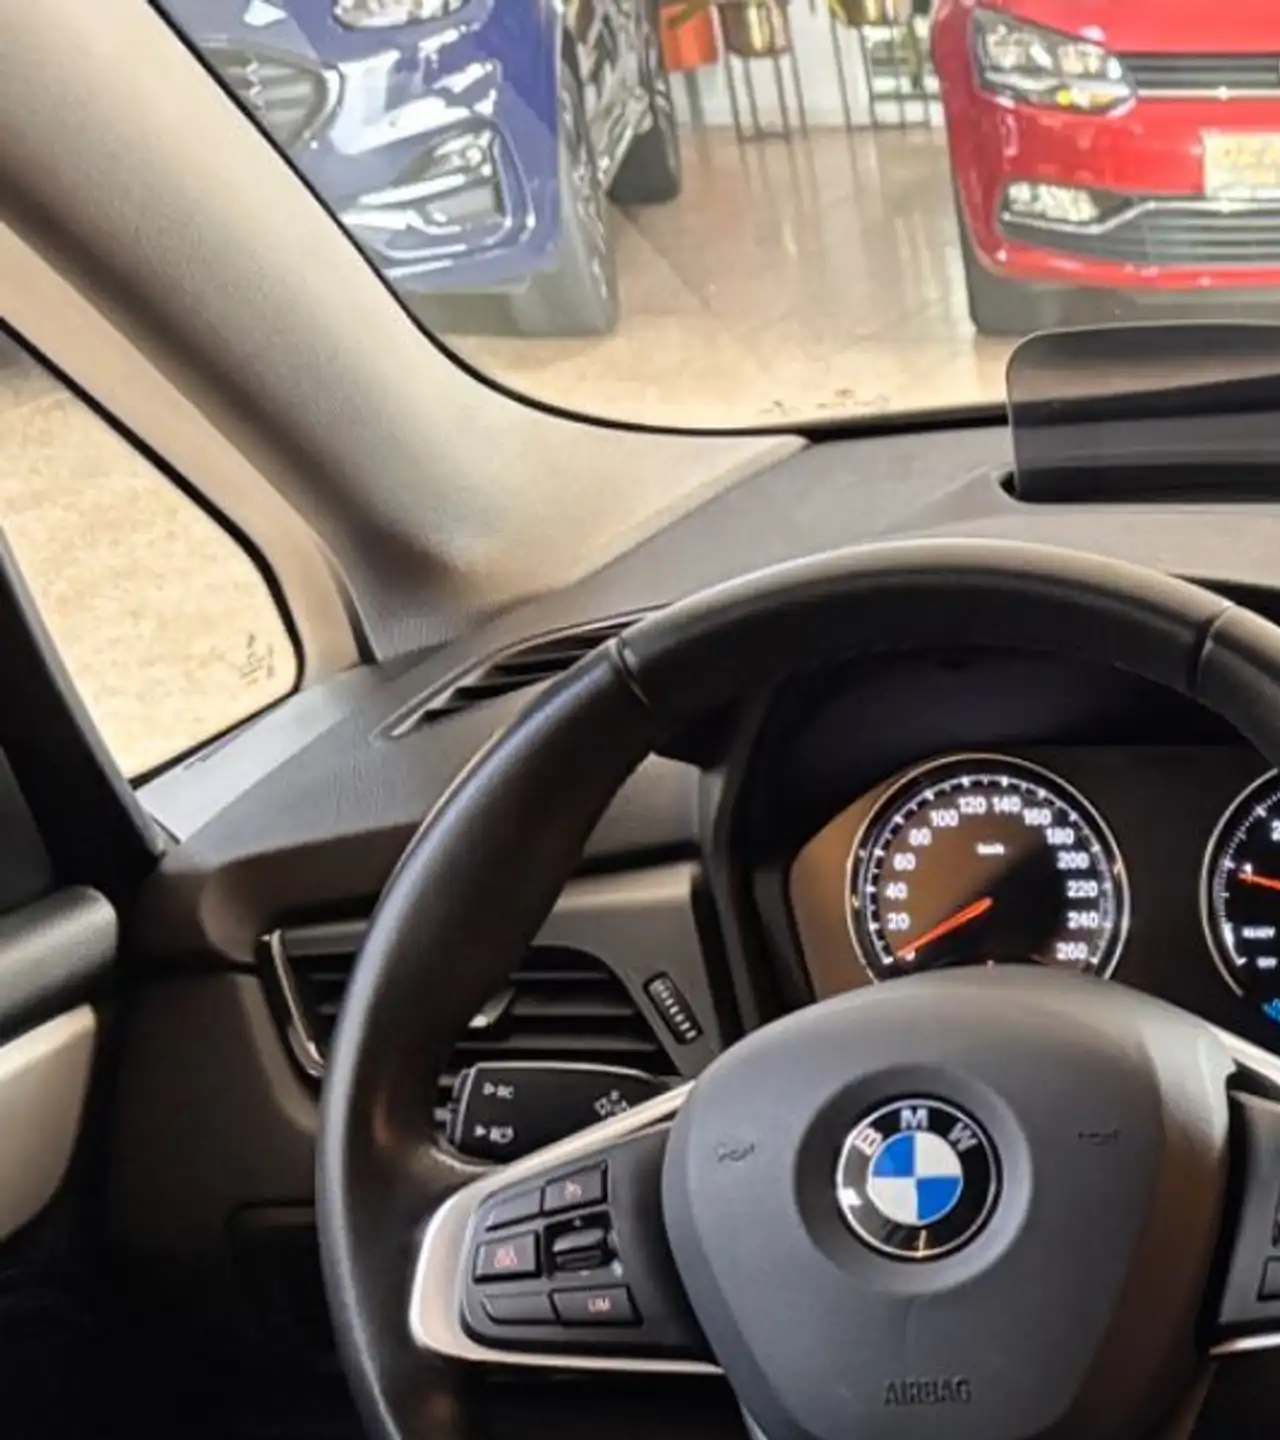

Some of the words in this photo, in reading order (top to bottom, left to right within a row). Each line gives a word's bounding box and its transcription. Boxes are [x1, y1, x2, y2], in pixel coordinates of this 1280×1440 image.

[958, 796, 987, 815] 120
[992, 796, 1022, 814] 140
[930, 808, 959, 827] 100
[1022, 808, 1052, 826] 160
[1045, 828, 1074, 845] 180
[1056, 852, 1091, 870] 200
[885, 882, 908, 900] 40
[1066, 880, 1098, 898] 220
[886, 912, 911, 931] 20
[1067, 911, 1098, 929] 240
[1056, 941, 1089, 961] 260
[854, 1107, 977, 1157] BMW
[884, 1377, 972, 1406] AIRBAG
